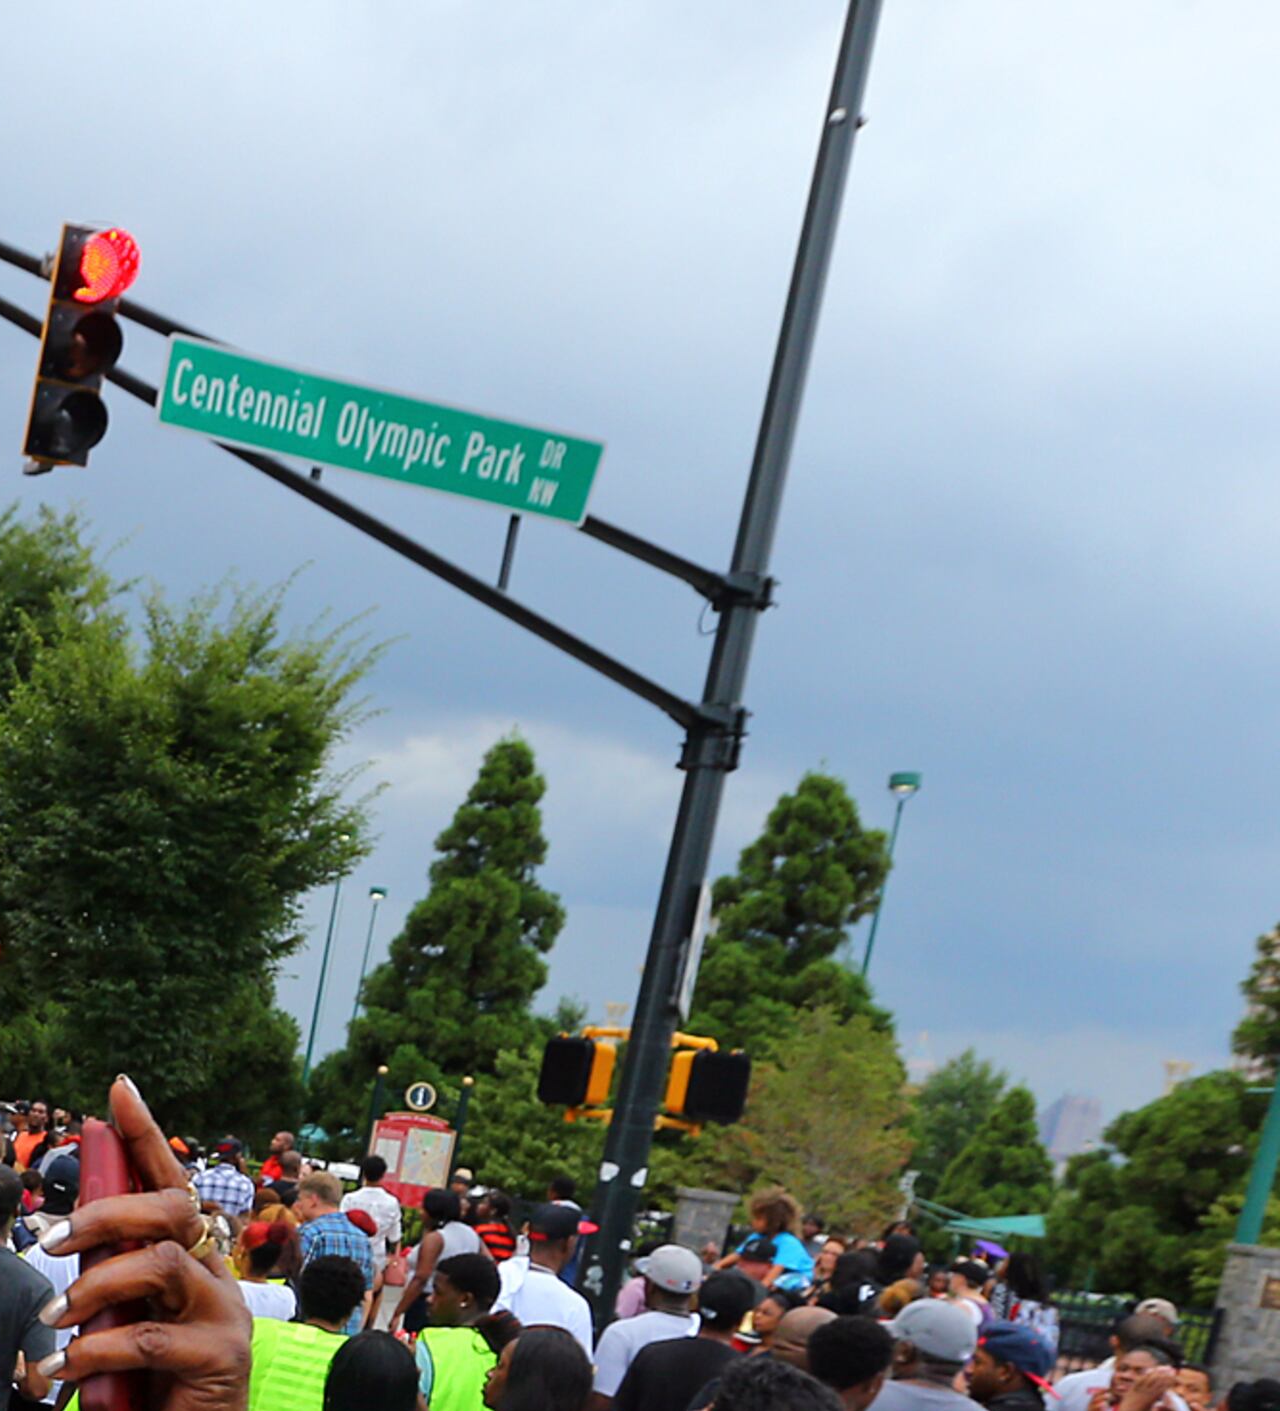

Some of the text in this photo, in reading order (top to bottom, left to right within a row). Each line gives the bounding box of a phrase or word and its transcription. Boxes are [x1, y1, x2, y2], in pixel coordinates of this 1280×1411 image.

[172, 358, 567, 485] Centennial Olympic Park DR
[526, 476, 559, 508] NW
